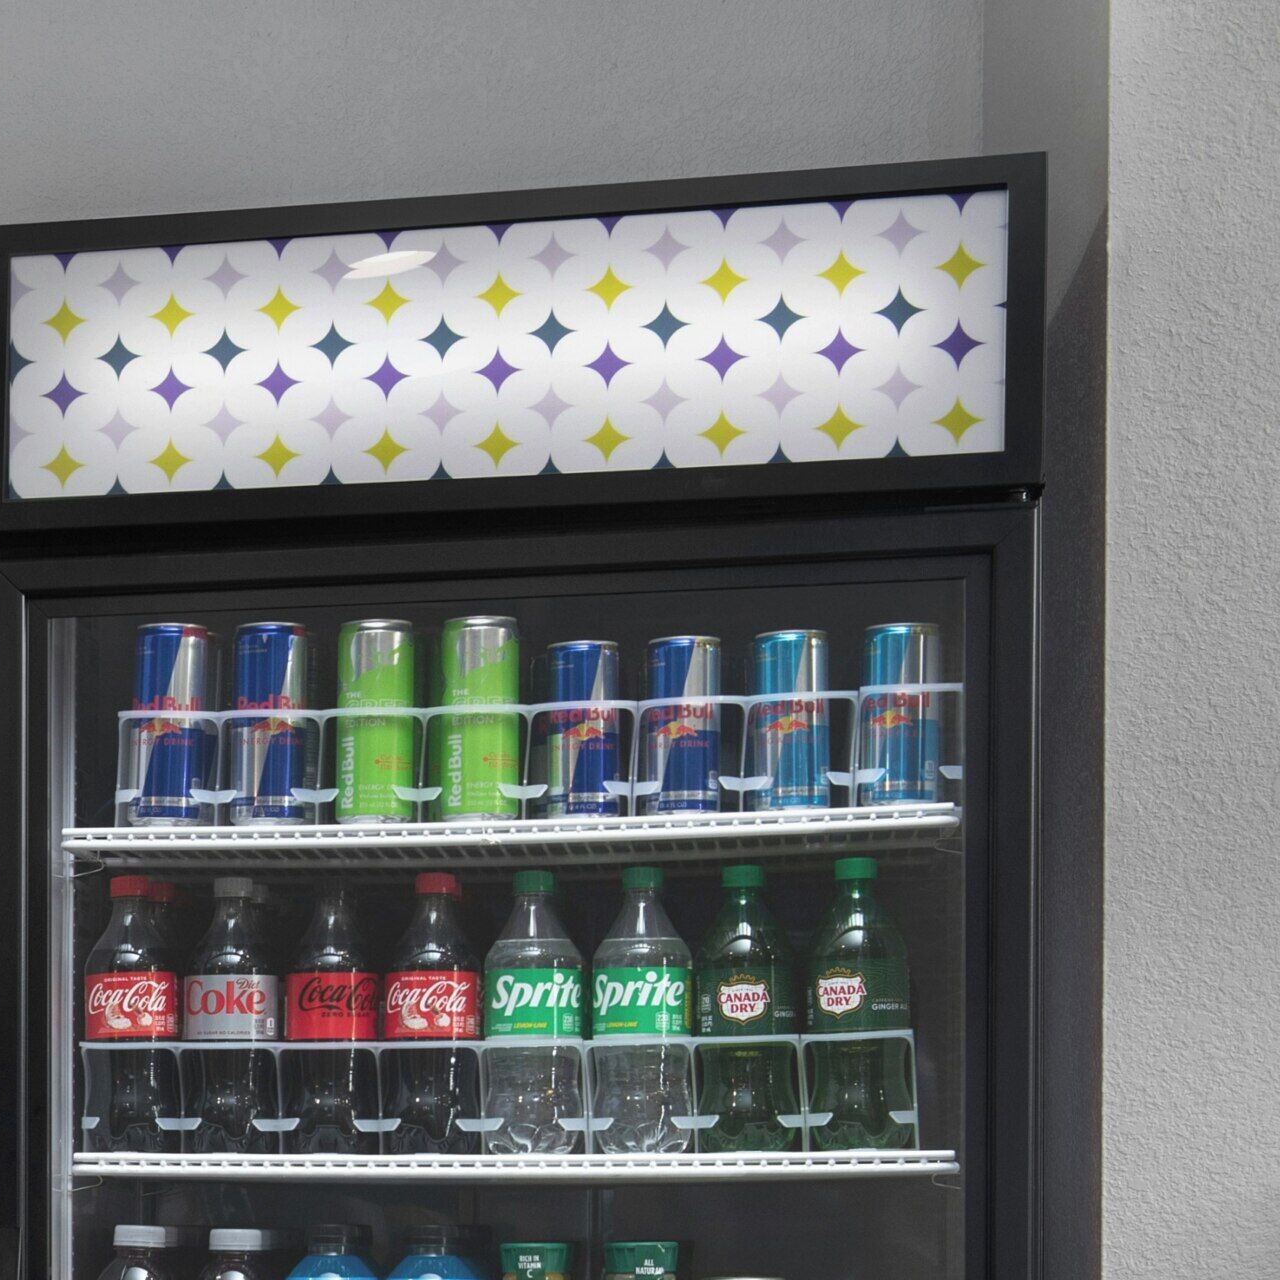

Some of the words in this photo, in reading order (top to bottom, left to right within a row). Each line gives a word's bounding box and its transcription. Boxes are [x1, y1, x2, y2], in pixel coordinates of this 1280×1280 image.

[236, 978, 259, 989] Diet
[491, 972, 582, 1016] Sprite
[88, 981, 168, 1013] Coca-Cola
[187, 980, 266, 1016] Coke
[718, 991, 769, 1004] CANADA
[731, 1003, 756, 1014] DRY
